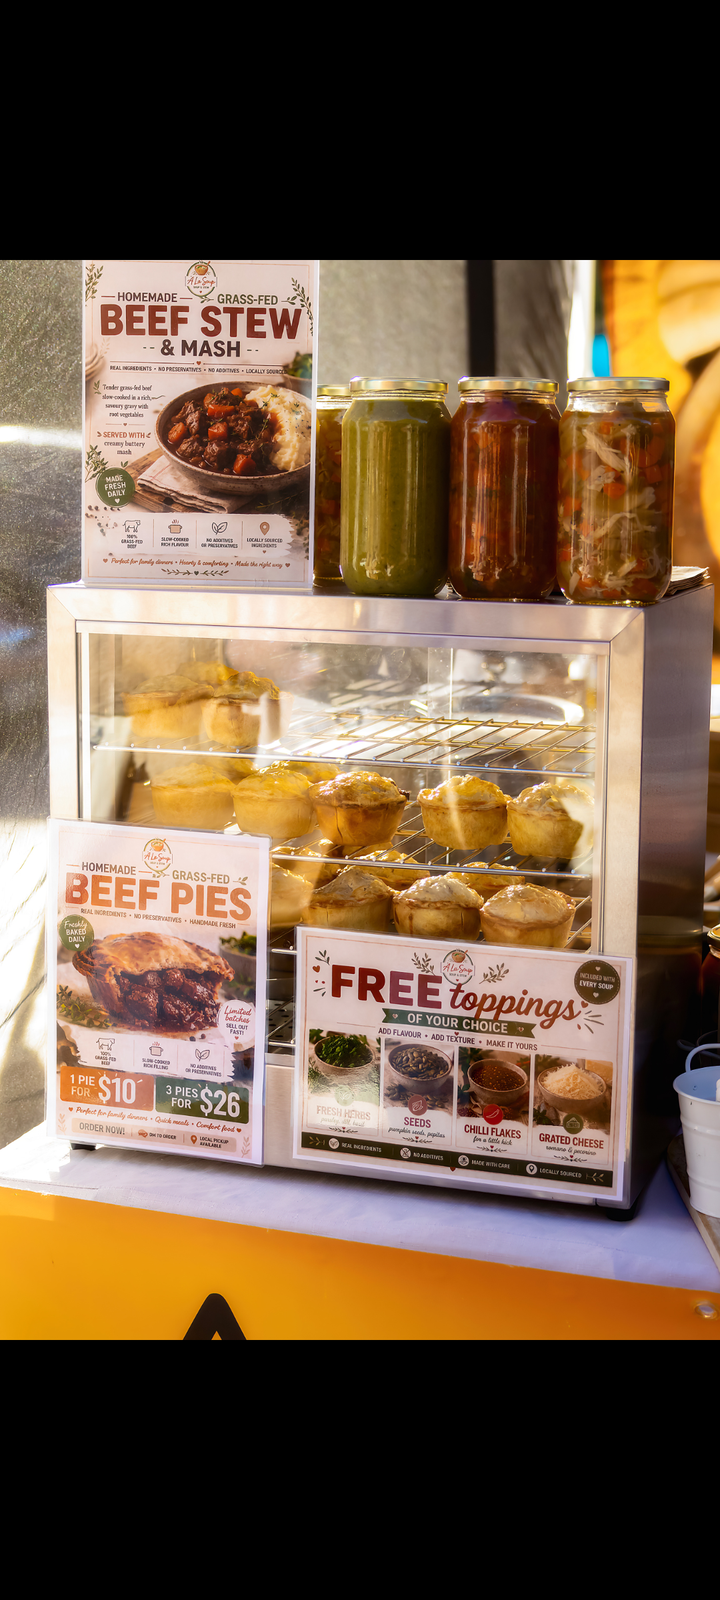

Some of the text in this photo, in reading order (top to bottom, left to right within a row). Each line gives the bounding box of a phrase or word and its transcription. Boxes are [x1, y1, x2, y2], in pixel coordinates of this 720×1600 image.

[118, 292, 278, 305] HOMEMADE GRASS-FED
[100, 304, 302, 339] BEEF STEW
[161, 339, 240, 357] & MASH
[105, 482, 126, 490] FRESH
[82, 862, 230, 884] HOMEMADE GRASS-FED
[65, 872, 252, 921] BEEF PIES
[65, 920, 87, 929] Freshly
[94, 909, 127, 918] INGREDIENTS
[142, 914, 182, 923] PRESERVATIVES
[189, 918, 218, 927] HANDMADE
[332, 964, 582, 1029] FREE toppings
[224, 1006, 252, 1016] Limited
[225, 1014, 250, 1023] batches
[407, 1013, 508, 1033] OF YOUR CHOICE
[393, 1029, 422, 1038] FLAVOUR
[446, 1035, 475, 1044] TEXTURE
[486, 1039, 506, 1048] MAKE
[70, 1074, 95, 1086] 1 PIE
[71, 1086, 90, 1097] FOR
[98, 1072, 136, 1104] $10
[166, 1085, 199, 1098] 3 PIES
[171, 1098, 191, 1109] FOR
[200, 1084, 240, 1118] $26
[76, 1106, 96, 1115] Perfect
[107, 1110, 125, 1120] family
[196, 1121, 221, 1131] Comfort
[316, 1105, 370, 1120] FRESH HERBS
[79, 1122, 125, 1135] ORDER NOW!
[404, 1117, 431, 1128] SEEDS
[464, 1124, 521, 1139] CHILLI FLAKES
[539, 1133, 604, 1149] GRATED CHEESE
[353, 1144, 382, 1152] INGREDIENTS
[560, 1170, 582, 1178] SOURCED
